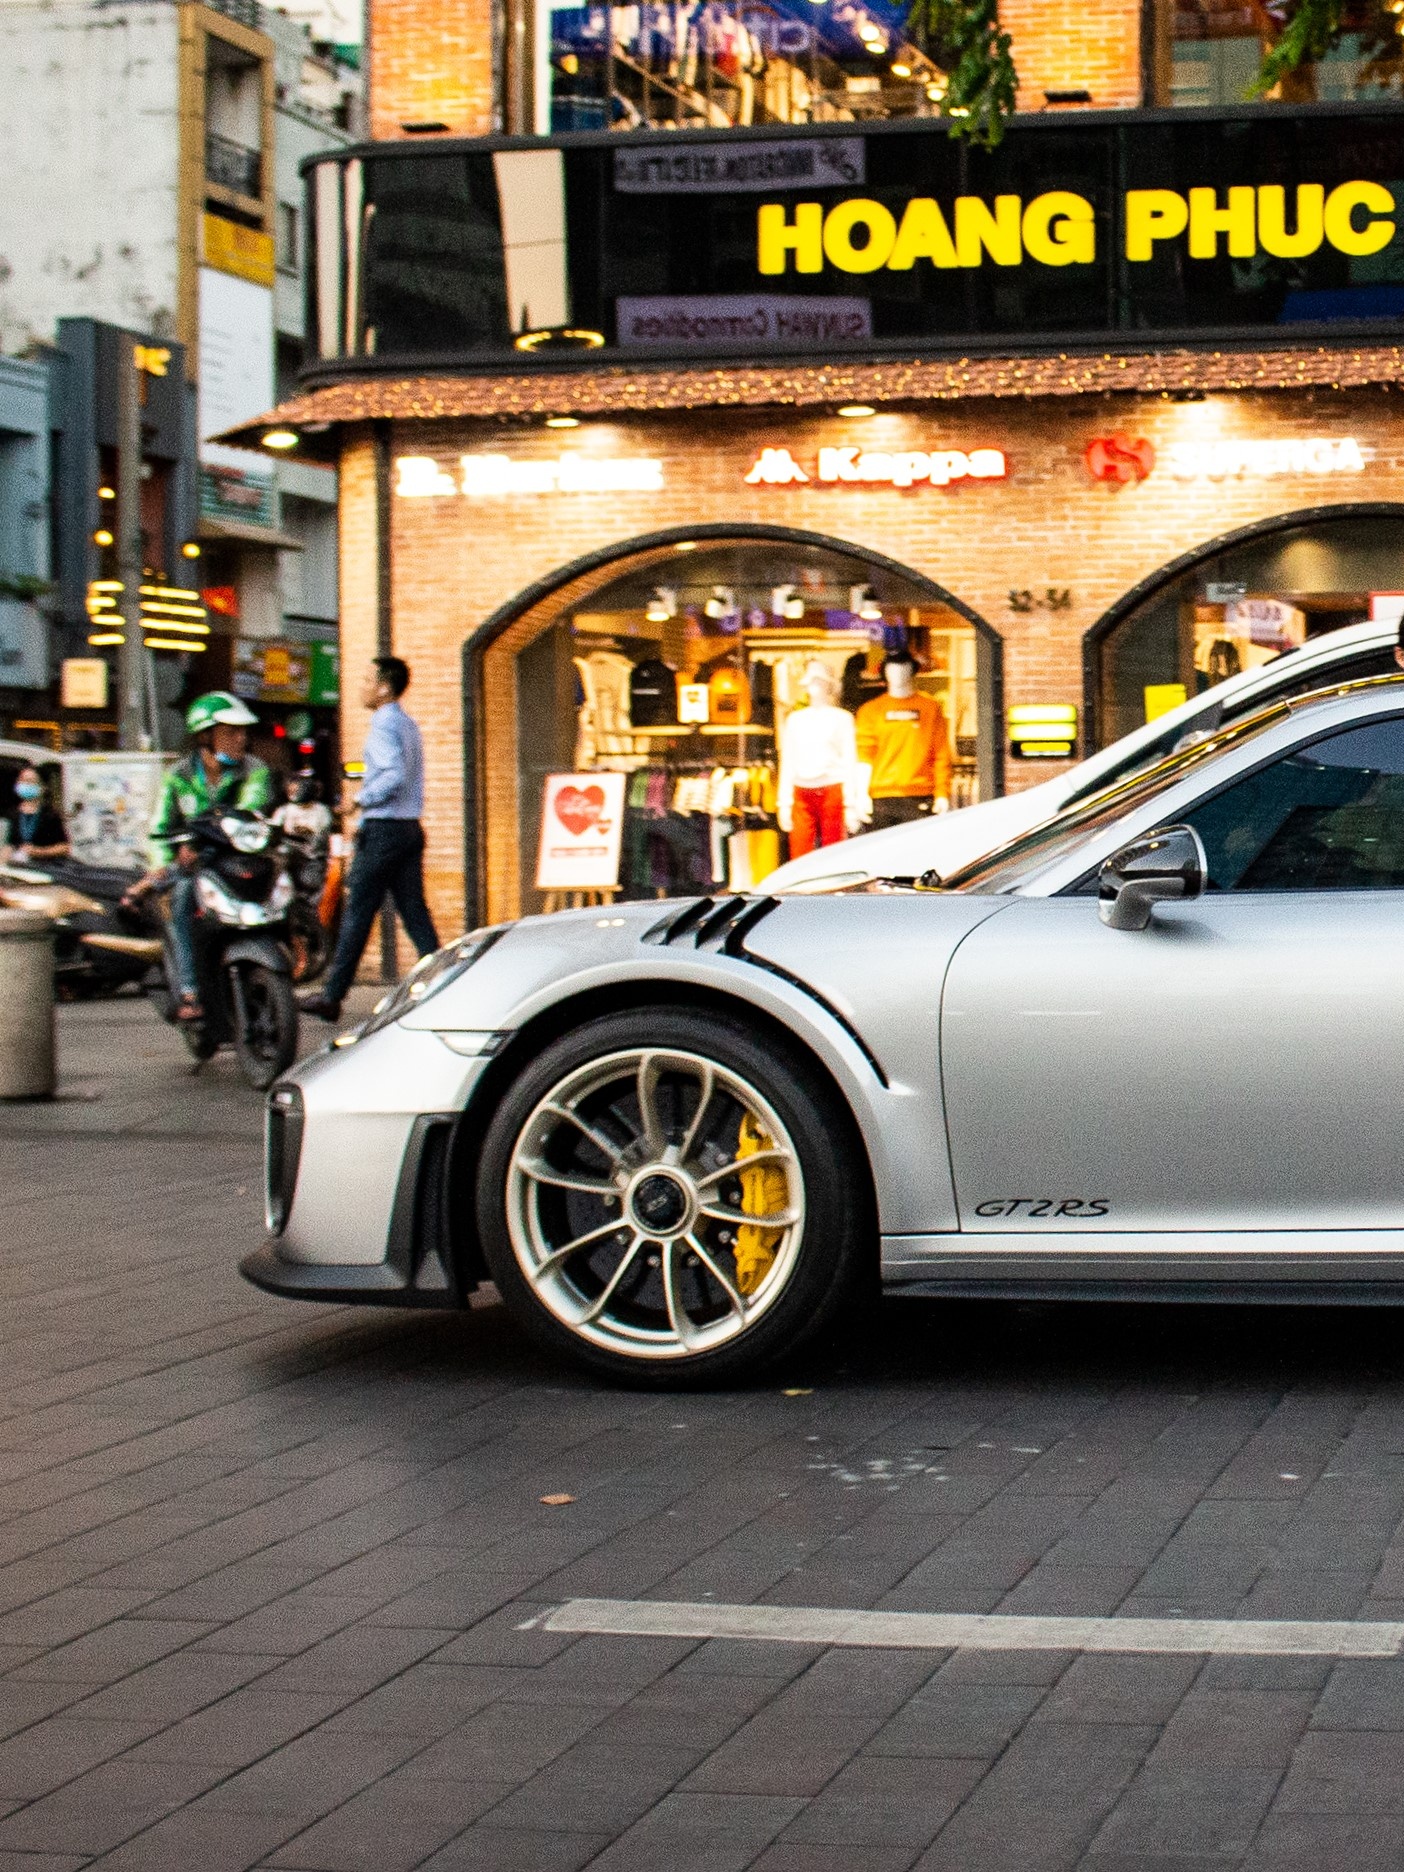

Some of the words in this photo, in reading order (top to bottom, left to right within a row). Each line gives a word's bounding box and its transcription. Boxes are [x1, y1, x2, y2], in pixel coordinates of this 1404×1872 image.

[757, 191, 1096, 275] HOANG
[1125, 180, 1396, 262] PHUC
[818, 446, 1005, 486] Kappa
